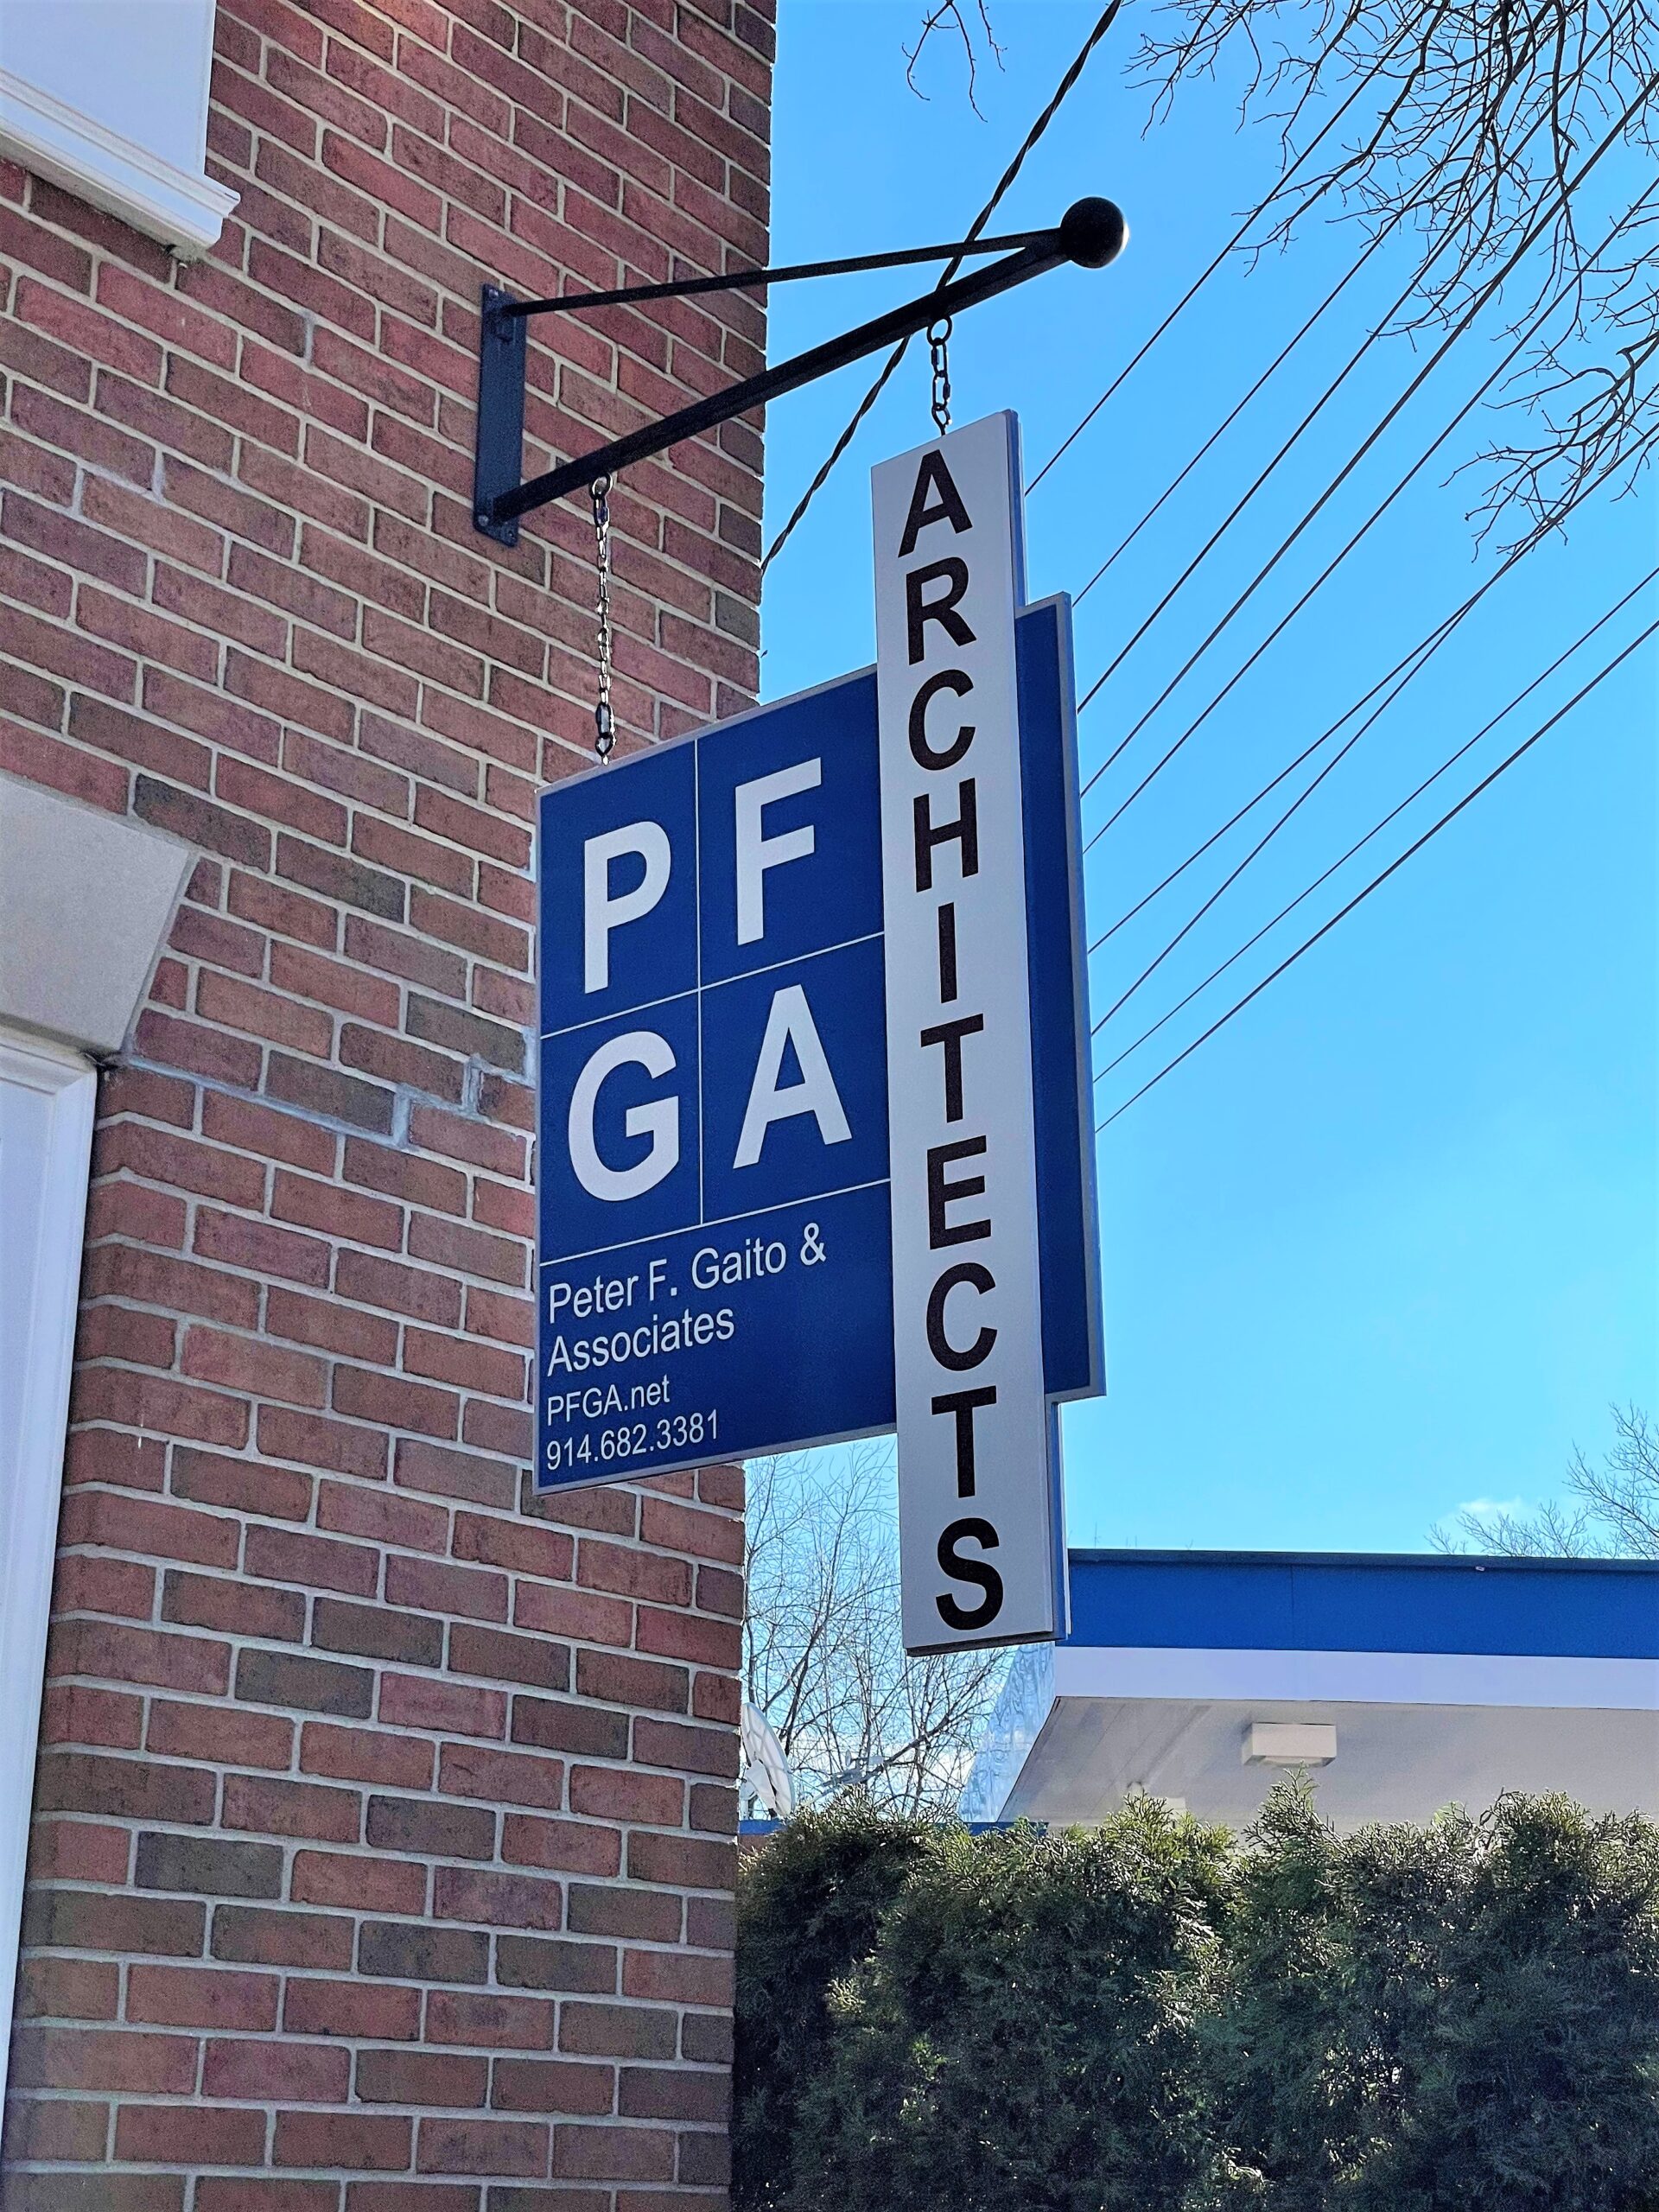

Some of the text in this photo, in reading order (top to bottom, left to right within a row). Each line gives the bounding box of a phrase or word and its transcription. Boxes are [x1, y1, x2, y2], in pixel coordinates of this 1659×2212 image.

[898, 448, 1004, 1630] ARCHITECTS
[549, 1222, 827, 1324] Peter F. Gaito &
[547, 1307, 735, 1377] Associates
[547, 1375, 671, 1427] PFGA.net
[546, 1409, 718, 1471] 914.682.3381
